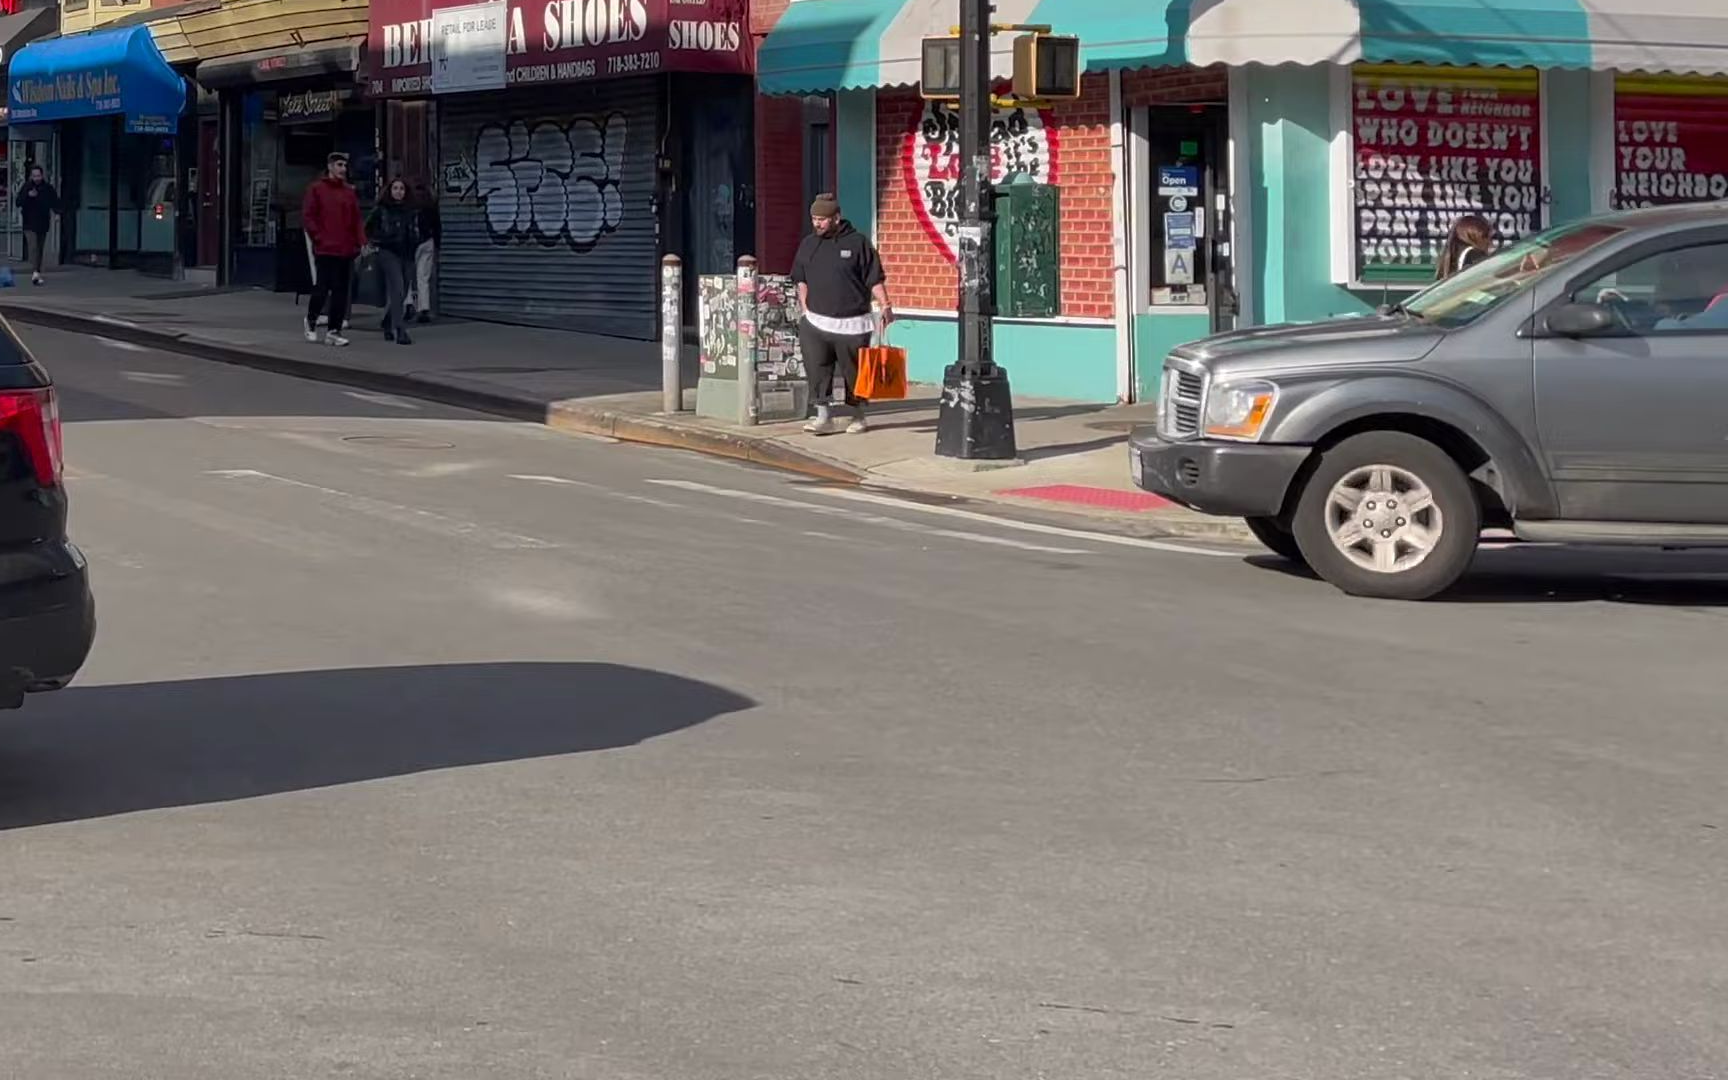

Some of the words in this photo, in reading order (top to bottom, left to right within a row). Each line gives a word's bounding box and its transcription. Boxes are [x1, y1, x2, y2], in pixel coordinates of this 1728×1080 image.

[668, 20, 740, 52] SHOES
[607, 51, 661, 74] 718-383-7210
[1355, 83, 1455, 114] LOVE
[1356, 118, 1419, 147] WHO
[1427, 120, 1533, 151] DOESN'T
[1618, 120, 1679, 143] LOVE
[1356, 153, 1423, 180] LOOK
[1429, 155, 1480, 182] LIKE
[1484, 157, 1534, 183] YOU
[1619, 146, 1686, 170] YOUR
[1162, 176, 1187, 186] Open
[1356, 180, 1427, 208] SPEAK
[1431, 183, 1484, 210] LIKE
[1488, 185, 1537, 212] YOU
[1360, 209, 1421, 235] PRAY
[1171, 253, 1188, 274] A
